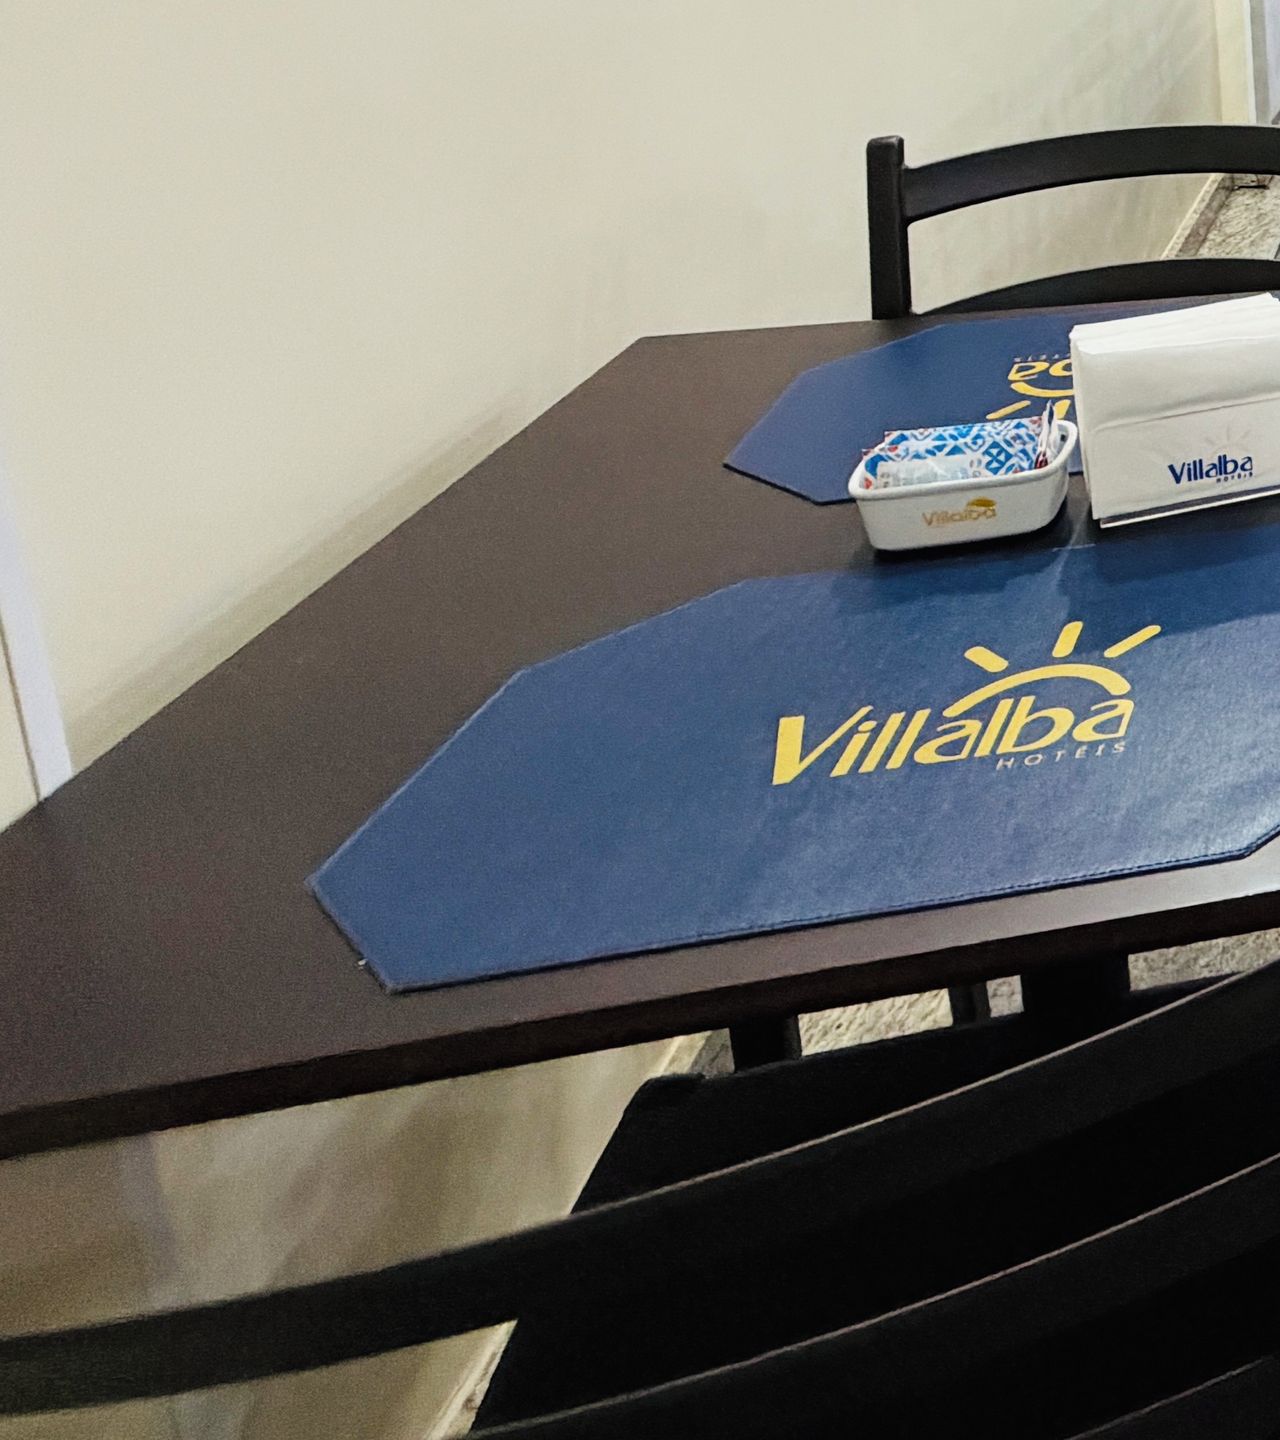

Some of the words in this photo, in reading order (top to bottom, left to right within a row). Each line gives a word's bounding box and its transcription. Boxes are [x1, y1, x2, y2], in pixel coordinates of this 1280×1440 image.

[1167, 454, 1253, 485] Villalba
[922, 506, 998, 526] Villalba
[772, 695, 1135, 786] Villalba
